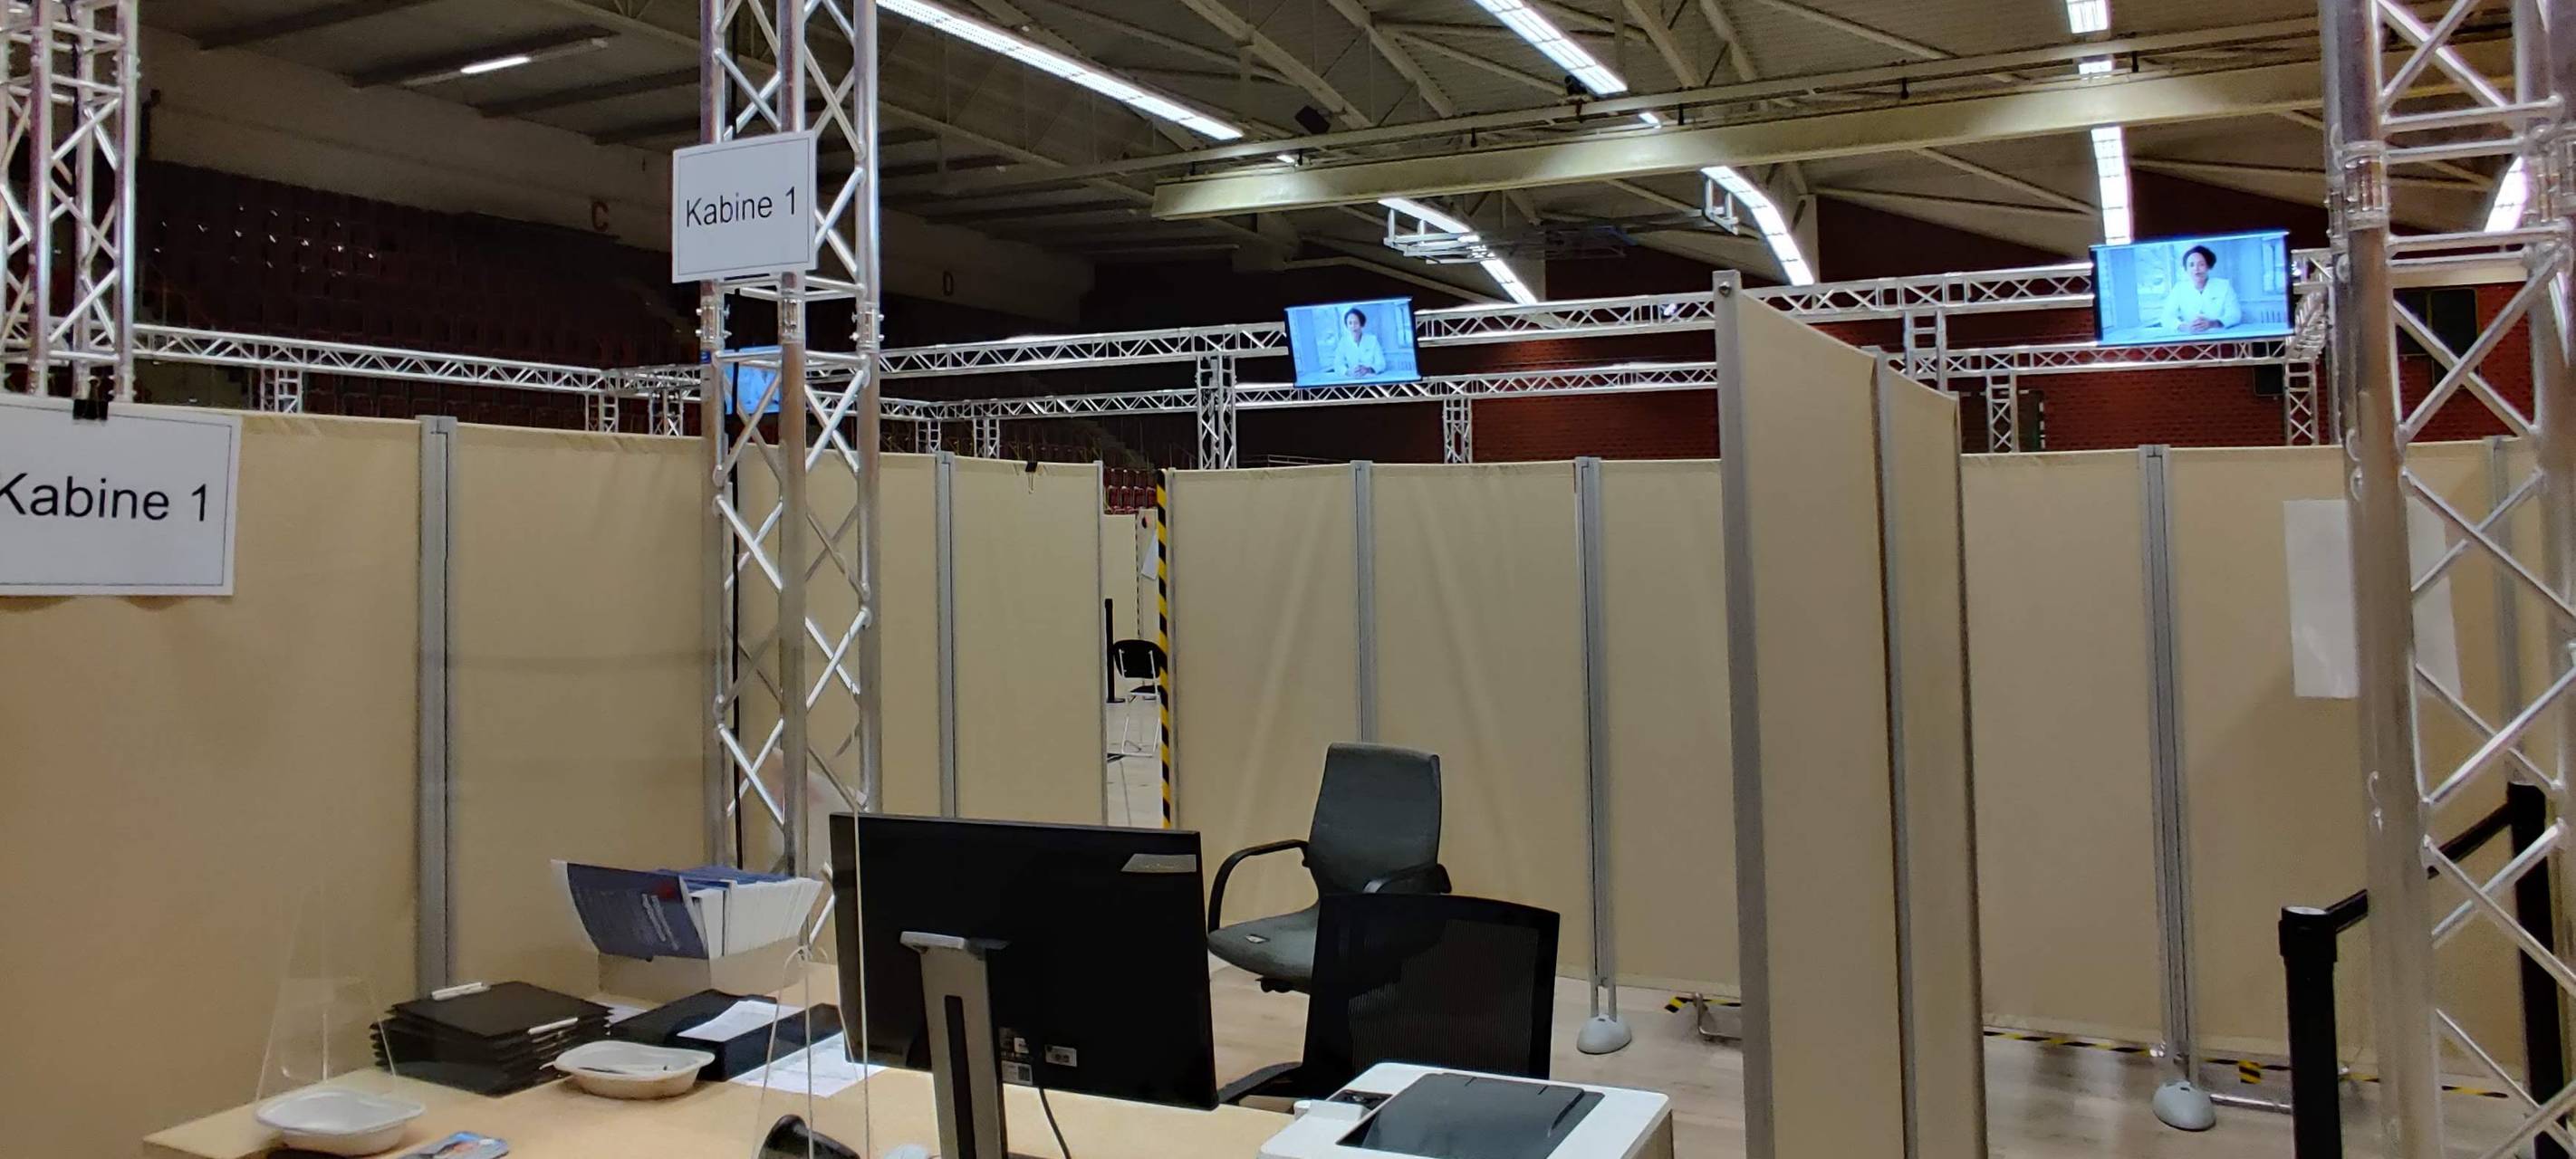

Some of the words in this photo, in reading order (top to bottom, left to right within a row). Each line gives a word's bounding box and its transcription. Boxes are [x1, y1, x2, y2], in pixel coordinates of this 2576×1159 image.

[591, 201, 609, 233] C
[687, 192, 773, 227] Kabine
[785, 186, 795, 216] 1
[0, 473, 169, 521] Kabine
[191, 483, 207, 522] 1
